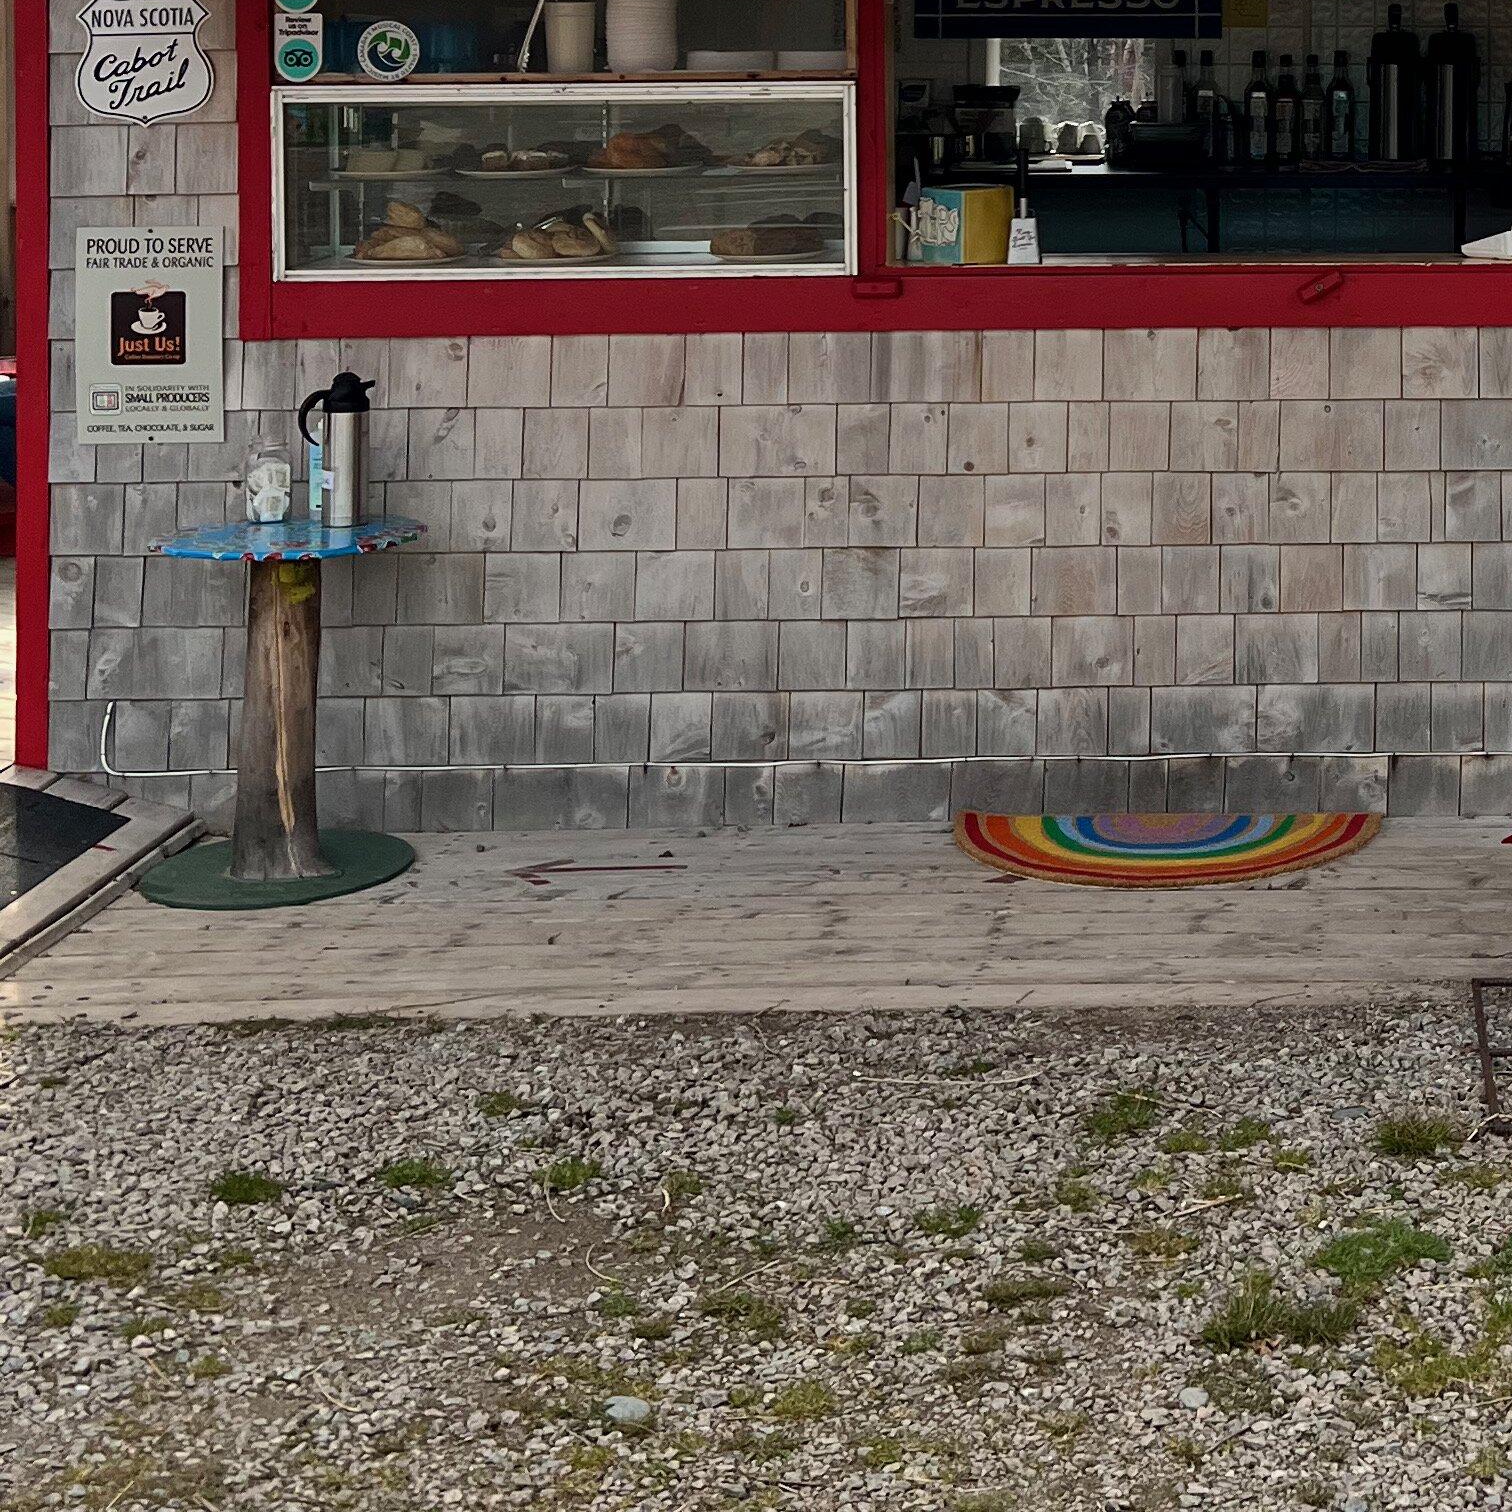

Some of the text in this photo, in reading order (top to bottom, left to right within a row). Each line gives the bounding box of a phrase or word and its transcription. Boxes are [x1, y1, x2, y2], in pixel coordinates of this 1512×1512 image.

[91, 8, 194, 27] NOVA SCOTIA
[93, 38, 178, 82] Cabot
[108, 57, 190, 110] Trail
[86, 237, 214, 254] PROUD TO SERVE
[86, 256, 214, 268] FAIR TRADE & ORGANIC
[117, 336, 181, 356] Just Us!
[125, 393, 210, 403] SMALL PRODUCERS
[189, 424, 215, 432] SUGAR
